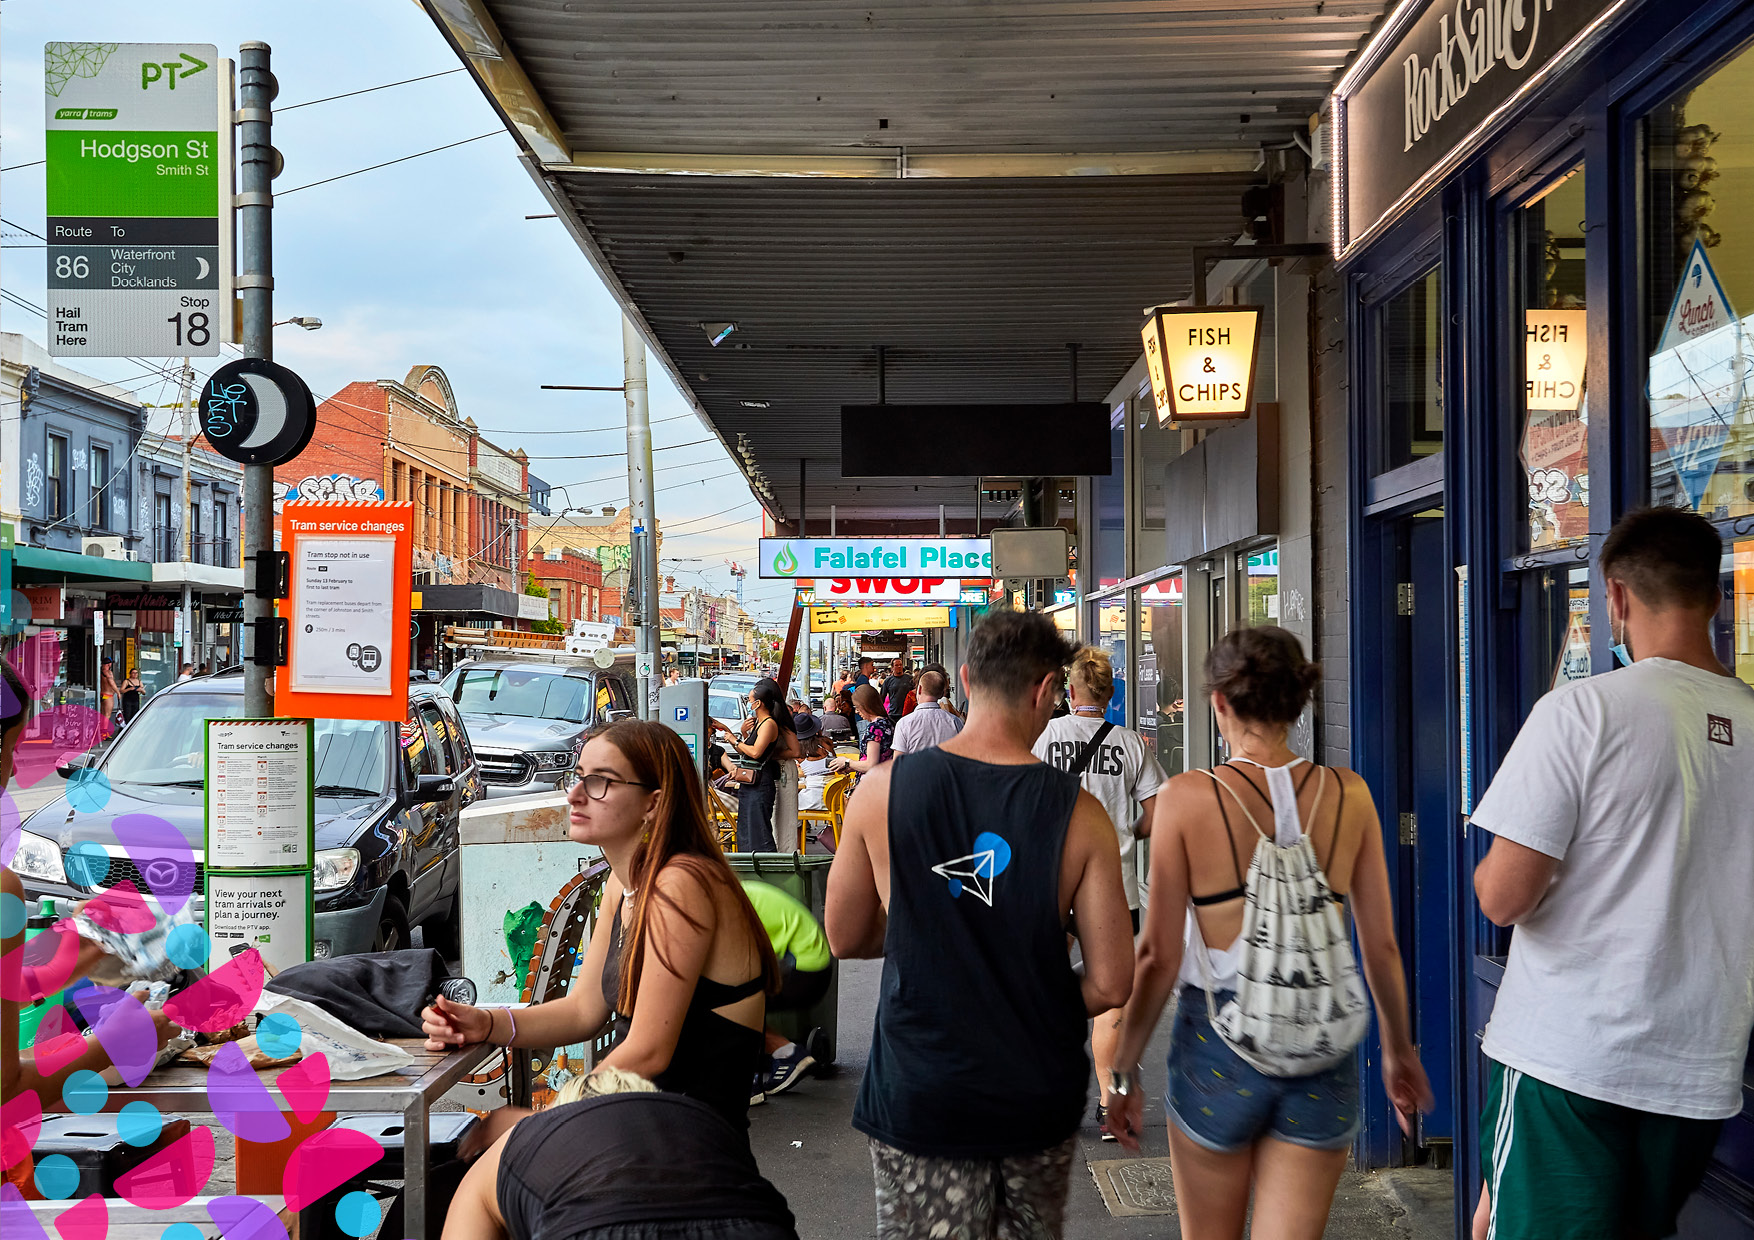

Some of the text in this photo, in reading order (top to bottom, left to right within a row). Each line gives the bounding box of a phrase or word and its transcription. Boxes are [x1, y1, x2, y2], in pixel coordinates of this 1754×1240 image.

[59, 110, 113, 118] yarra trams
[81, 139, 209, 163] Hodgson St
[156, 164, 209, 176] Smith St
[55, 225, 126, 238] Route To
[110, 248, 176, 261] Waterfront
[55, 255, 90, 279] 86
[110, 262, 136, 276] City
[111, 276, 177, 288] Docklands
[180, 296, 210, 309] Stop
[56, 307, 81, 318] Hail
[56, 321, 88, 332] Tram
[167, 312, 211, 347] 18
[56, 335, 87, 345] Here
[1188, 327, 1231, 346] FISH
[1203, 357, 1216, 373] &
[1179, 383, 1242, 402] CHIPS
[290, 519, 405, 534] Tram service changes
[814, 546, 991, 569] Falafel Place
[677, 709, 686, 720] P
[217, 742, 298, 751] Tram service changes
[215, 889, 282, 900] View your next
[236, 900, 272, 908] arrivals
[275, 899, 286, 908] or
[215, 910, 232, 920] plan
[241, 910, 280, 921] journey.
